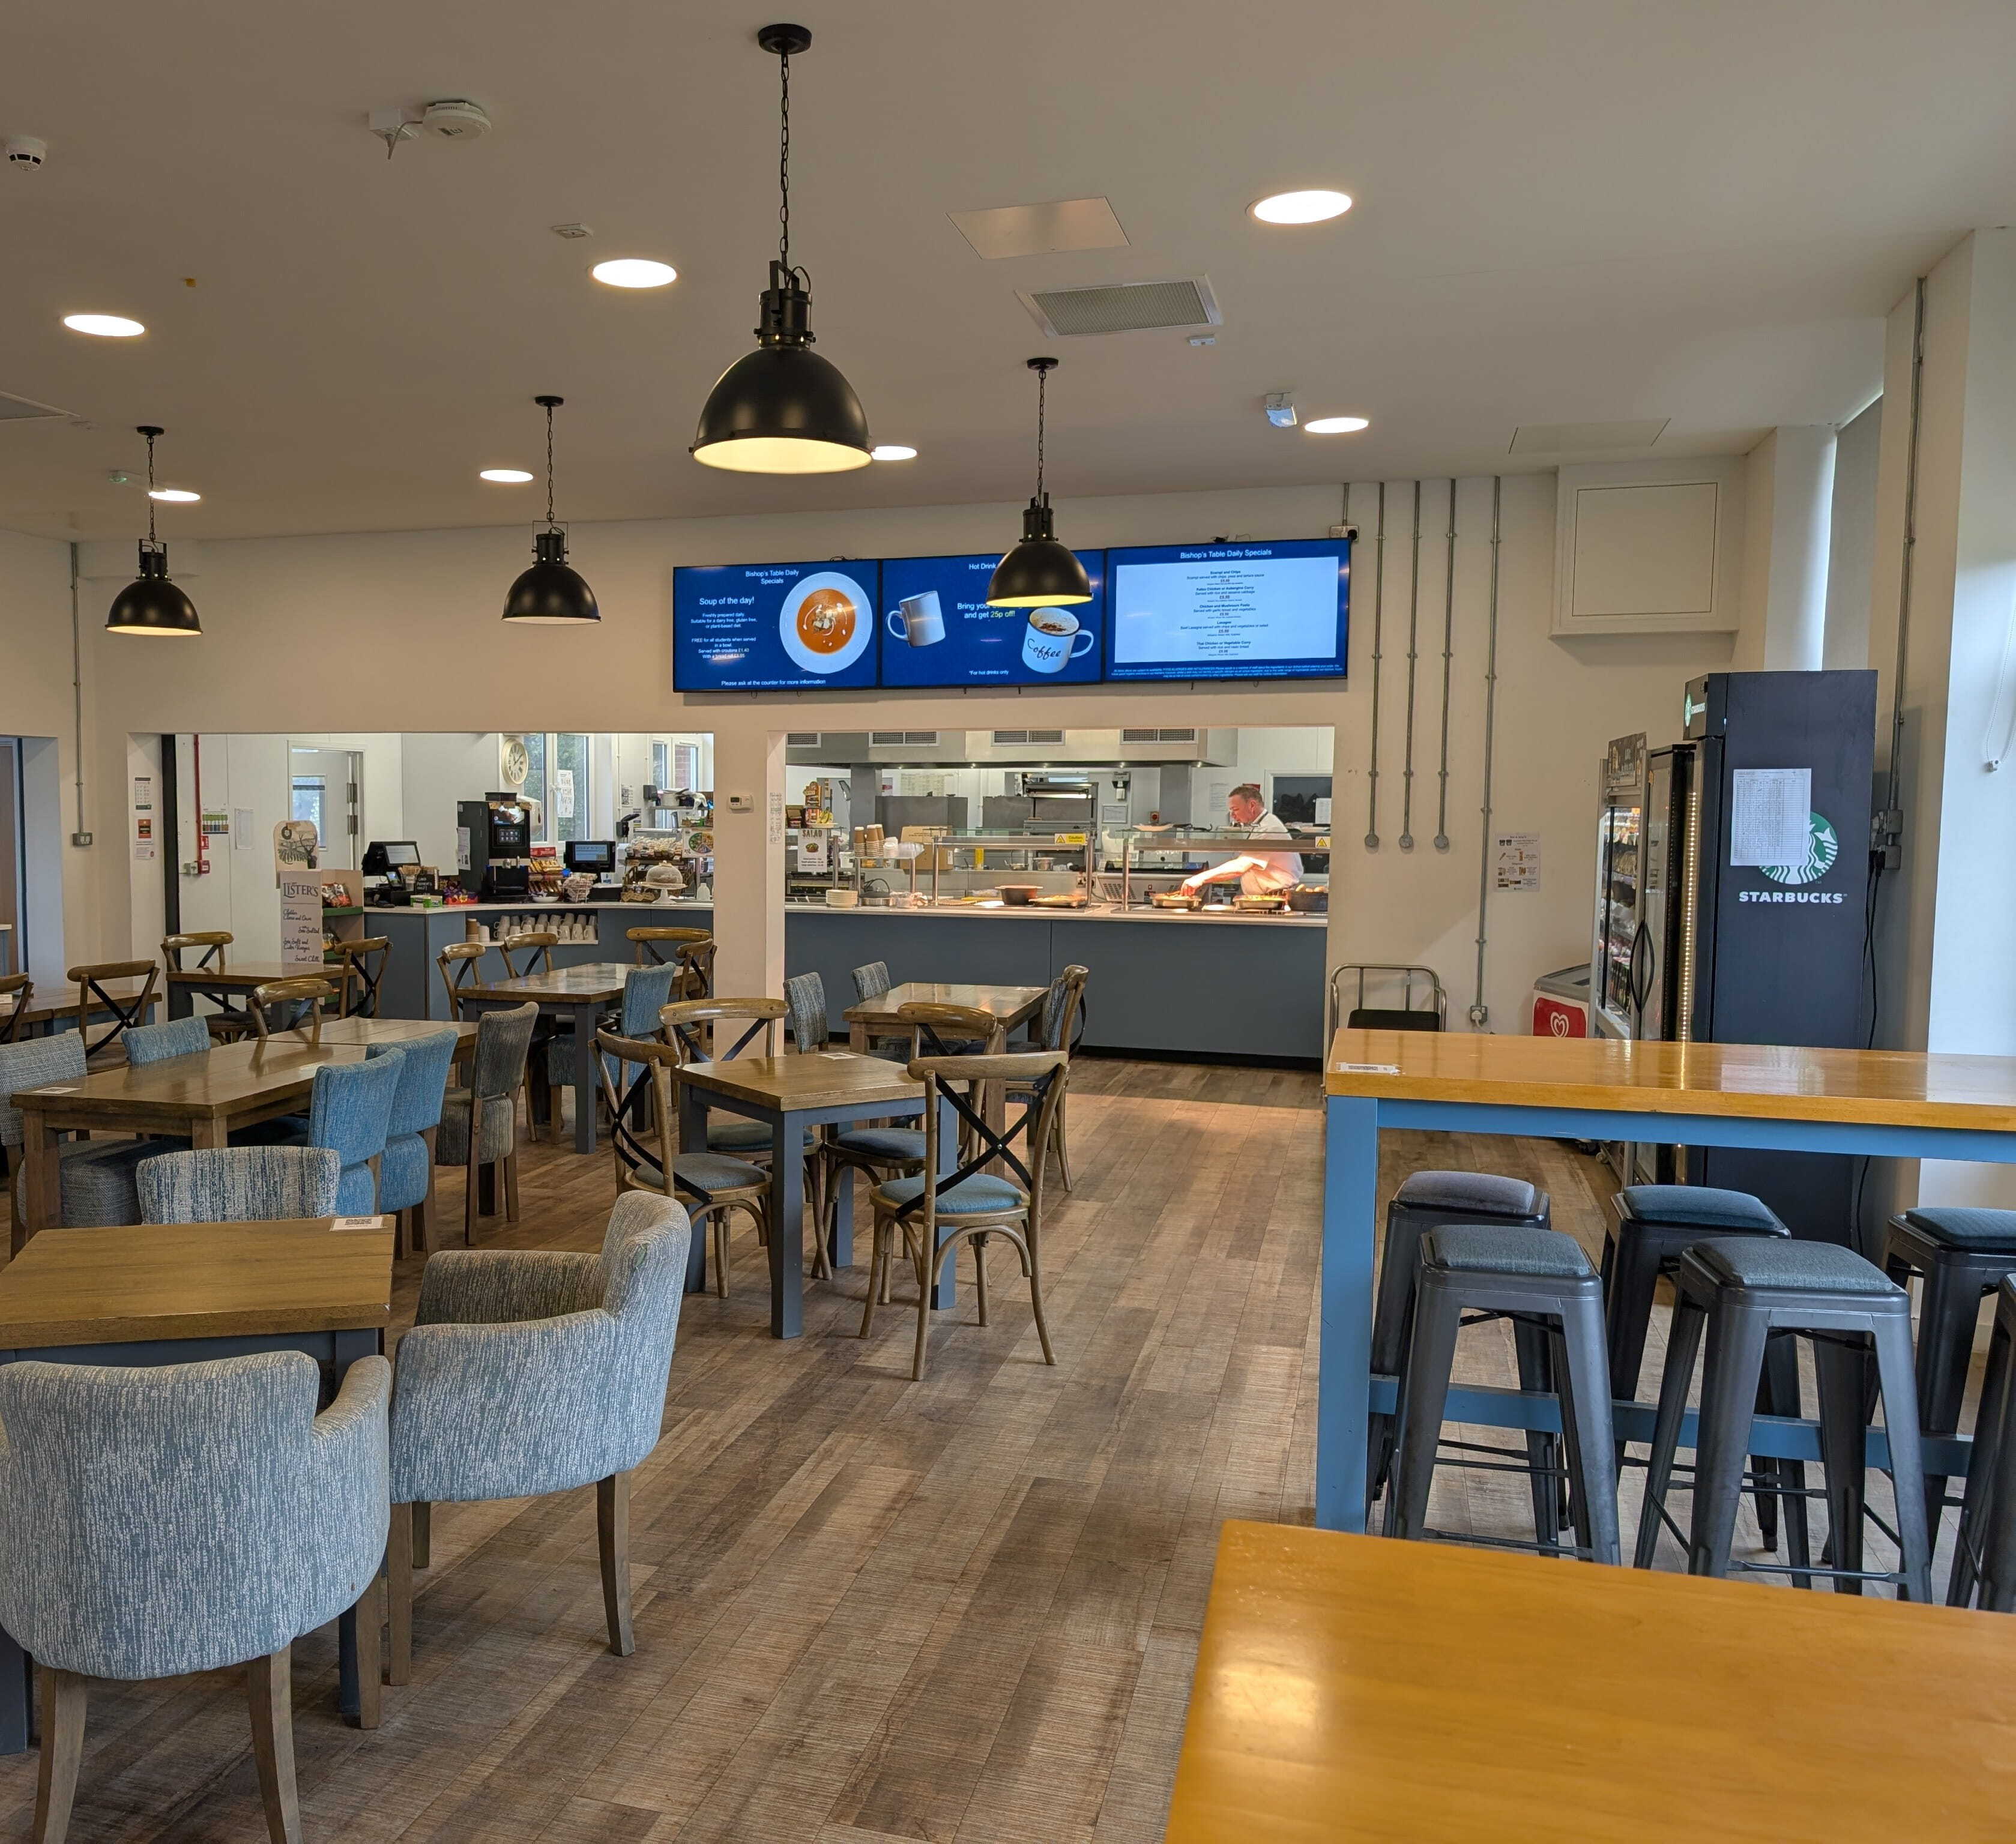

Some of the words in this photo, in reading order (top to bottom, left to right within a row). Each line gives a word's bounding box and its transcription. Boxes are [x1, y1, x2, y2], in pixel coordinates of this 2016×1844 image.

[740, 596, 755, 605] day!
[1028, 639, 1061, 660] Coffee
[1691, 702, 1705, 715] STARBUCKS
[283, 882, 319, 898] LISTER'S
[1739, 891, 1843, 903] STARBUCKS
